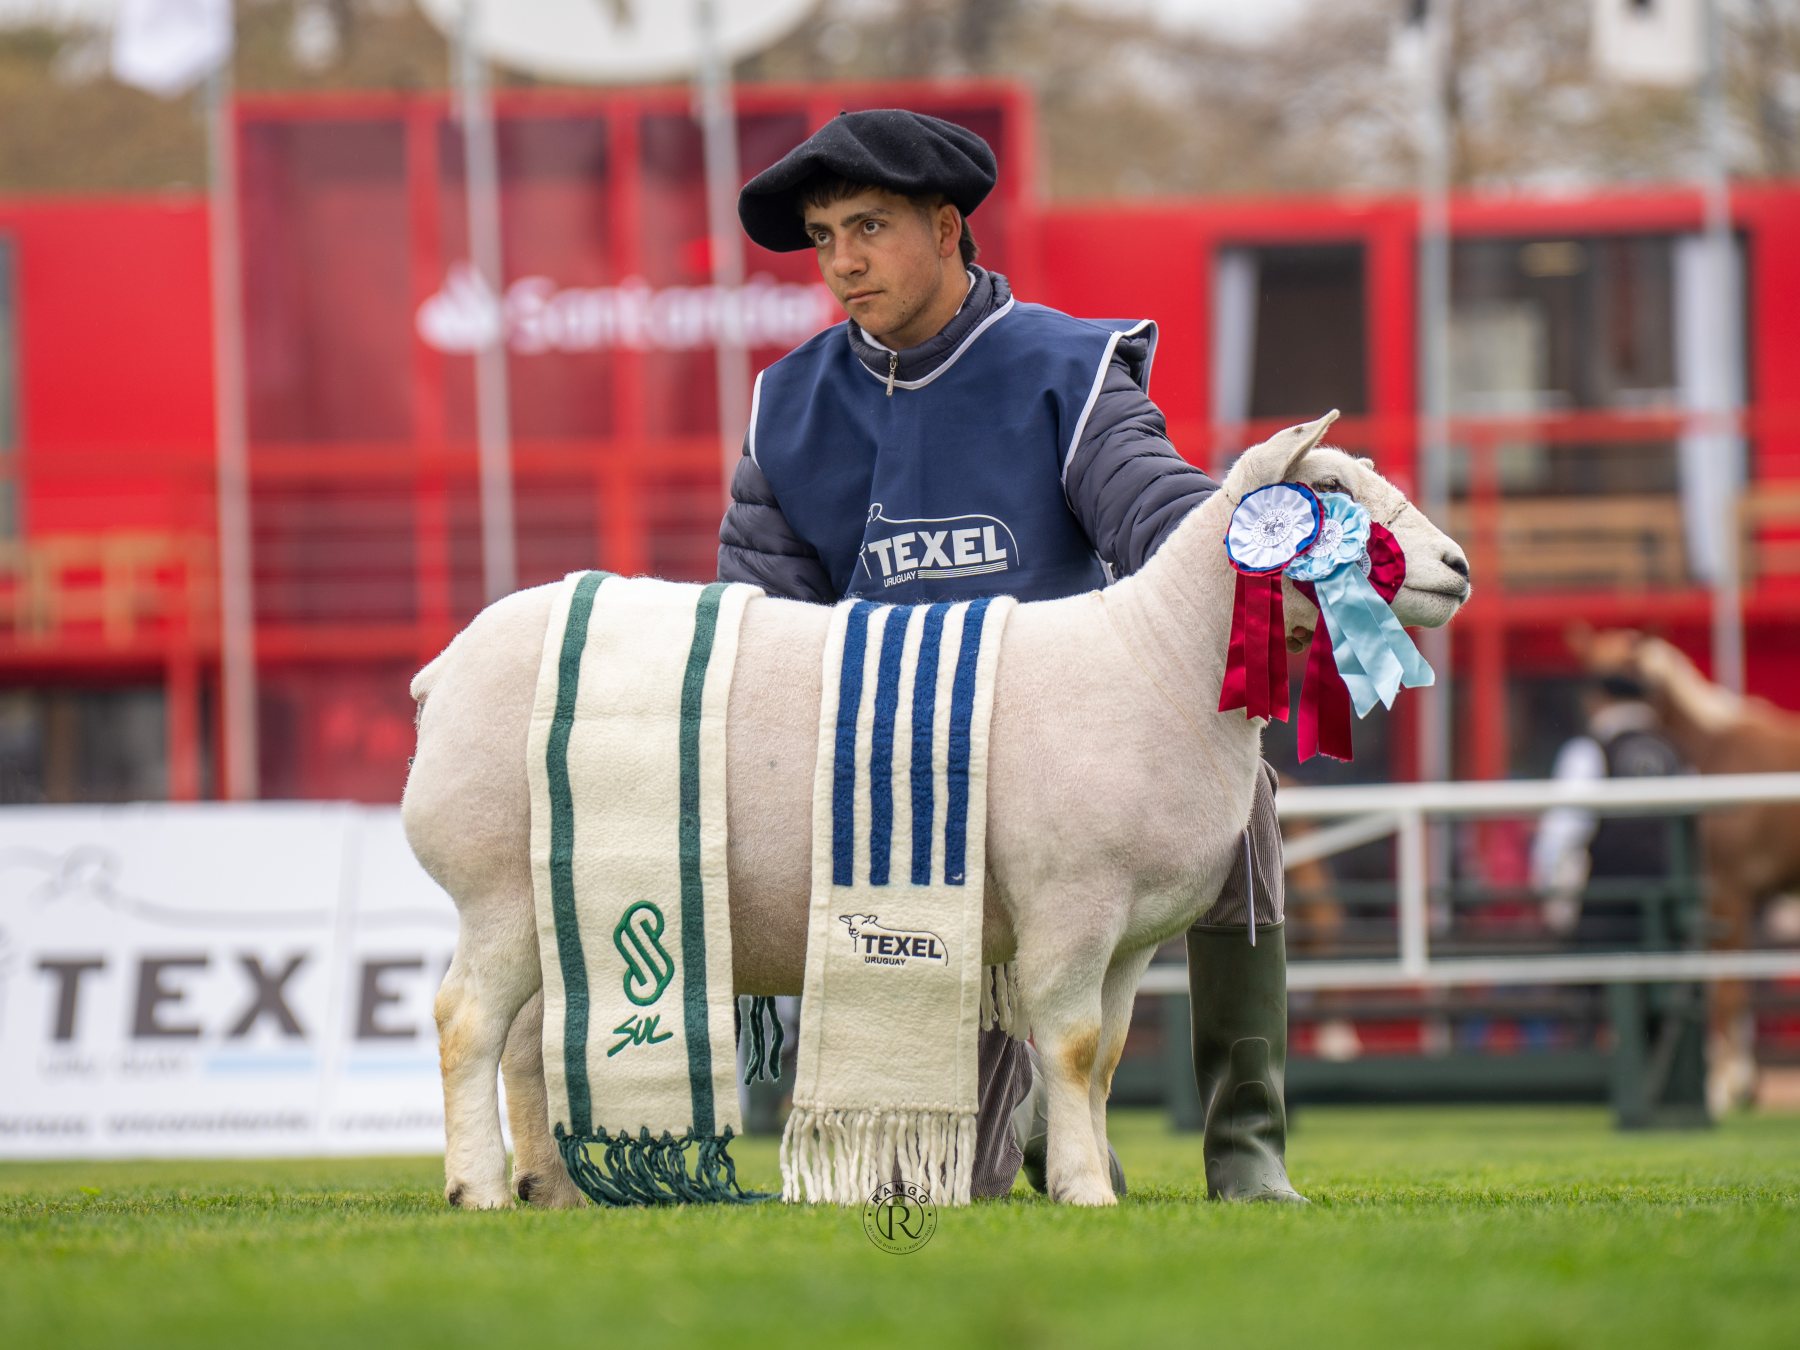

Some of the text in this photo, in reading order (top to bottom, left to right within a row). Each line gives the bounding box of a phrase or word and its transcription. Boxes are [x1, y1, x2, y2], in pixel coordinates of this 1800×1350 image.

[867, 525, 1007, 577] TEXEL
[884, 570, 917, 588] URUGUAY
[861, 934, 942, 959] TEXEL
[864, 956, 906, 965] URUGUAY
[36, 957, 454, 1041] TEXE
